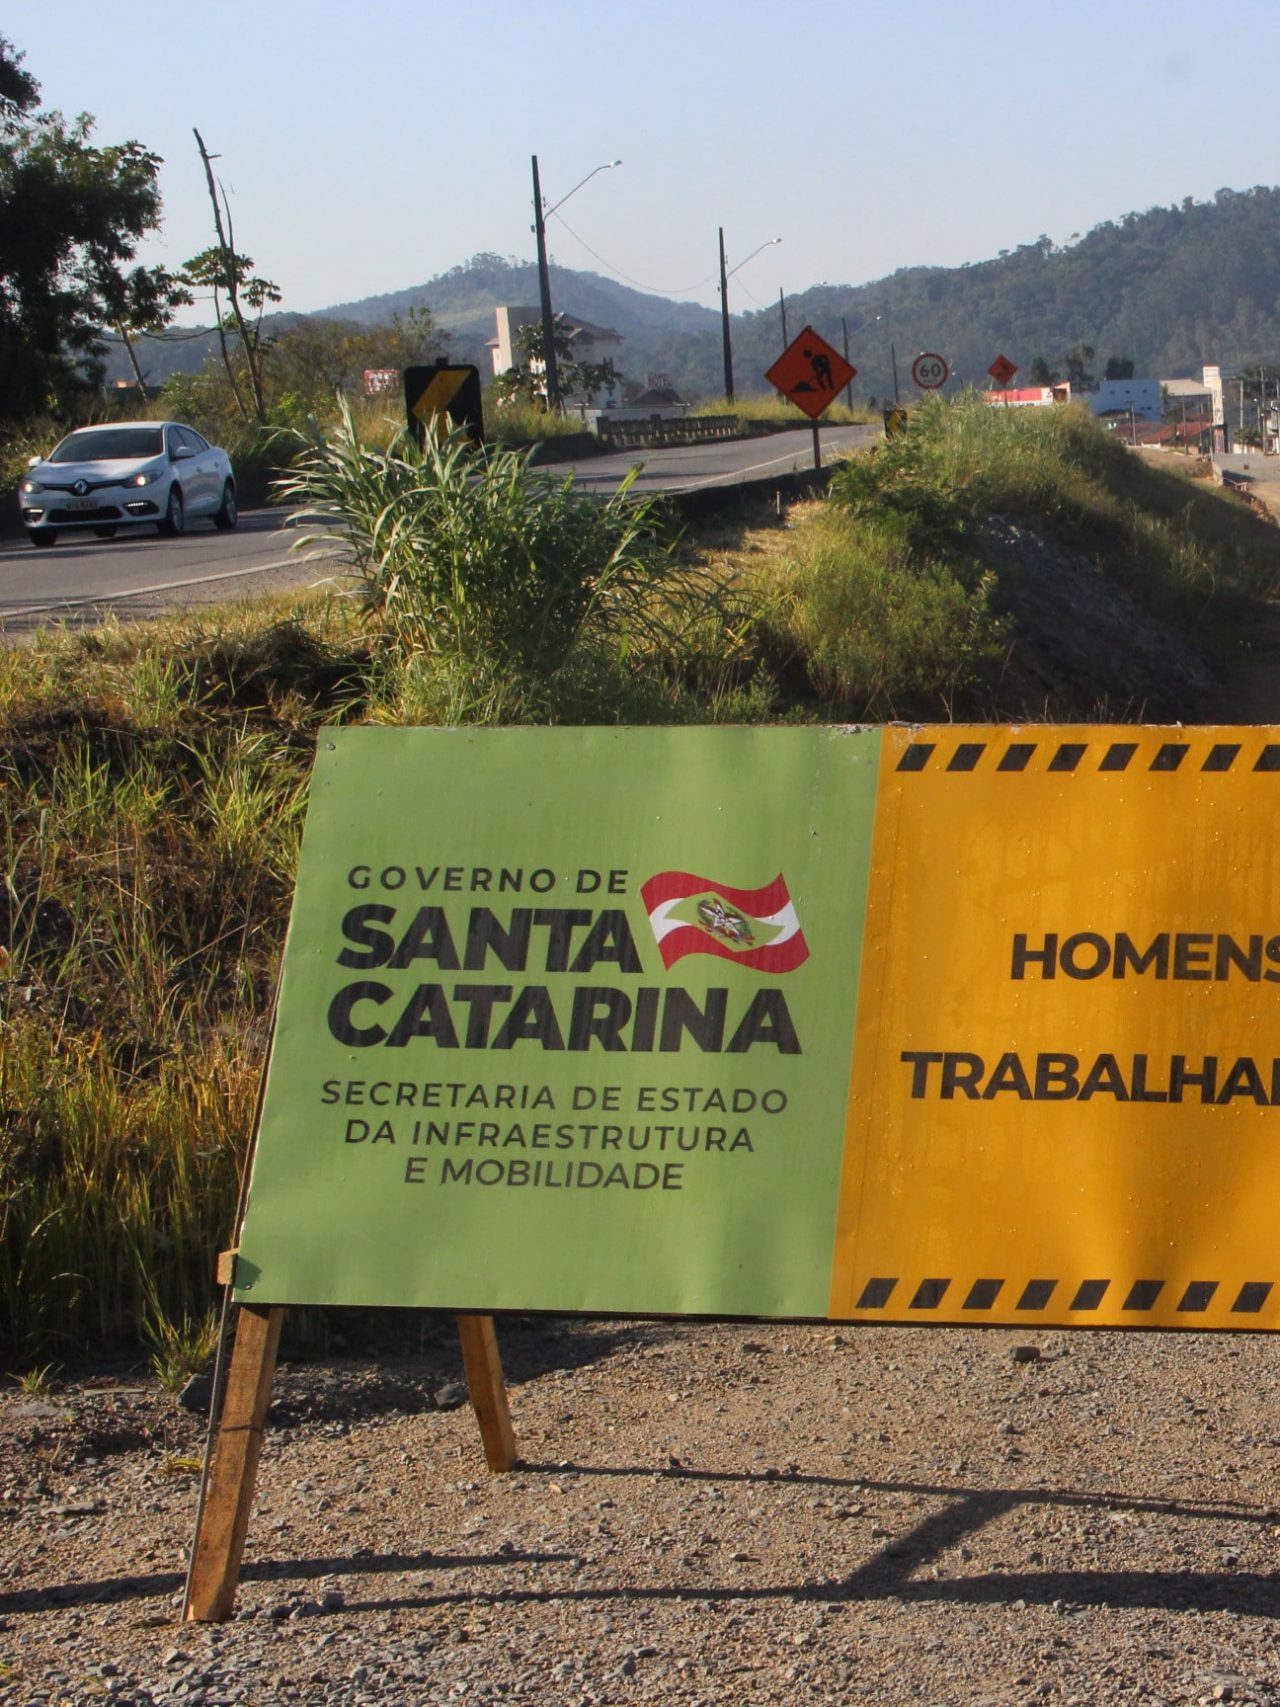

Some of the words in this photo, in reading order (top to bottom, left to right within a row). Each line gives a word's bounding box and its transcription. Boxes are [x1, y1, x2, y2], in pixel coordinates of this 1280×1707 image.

[920, 363, 941, 377] 60
[347, 865, 556, 894] GOVERNO
[575, 869, 628, 894] DE
[335, 903, 645, 974] SANTA
[327, 980, 803, 1056] CATARINA
[320, 1080, 556, 1110] SECRETARIA
[571, 1086, 622, 1111] DE
[636, 1087, 788, 1115] ESTADO
[344, 1119, 396, 1145] DA
[411, 1121, 755, 1153] INFRAESTRUTURA
[403, 1156, 428, 1184] E
[440, 1158, 684, 1191] MOBILIDADE
